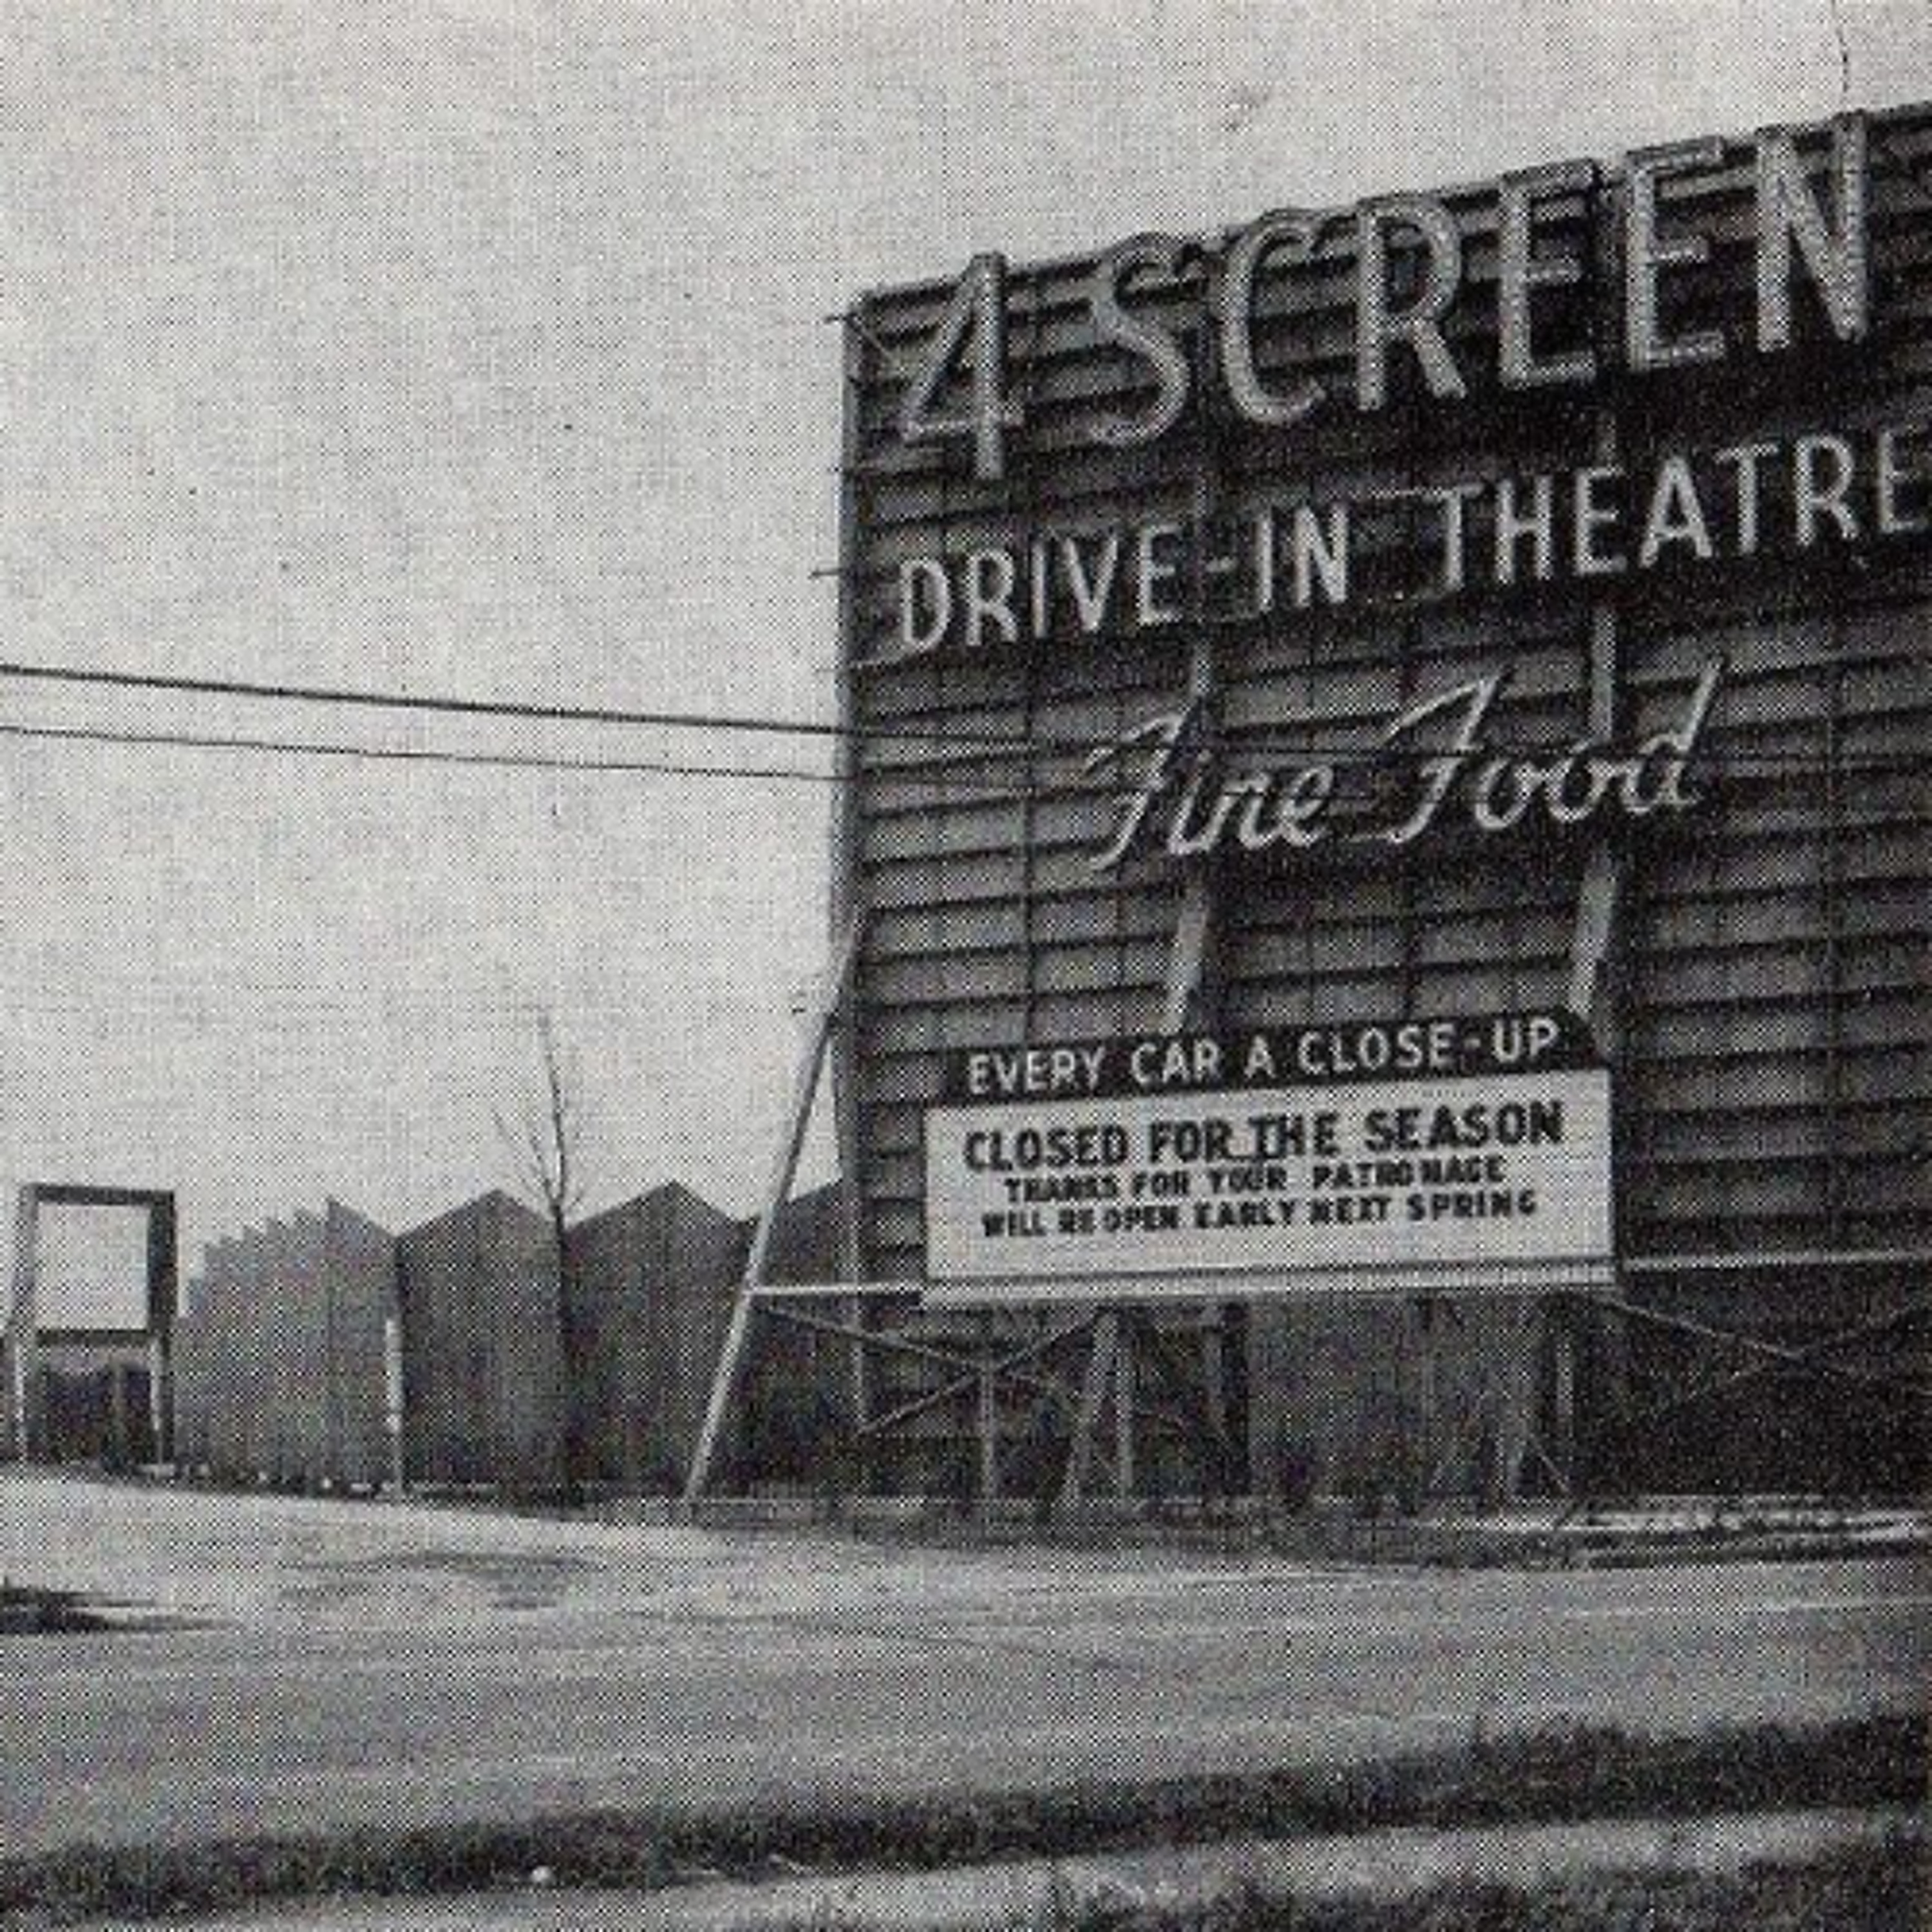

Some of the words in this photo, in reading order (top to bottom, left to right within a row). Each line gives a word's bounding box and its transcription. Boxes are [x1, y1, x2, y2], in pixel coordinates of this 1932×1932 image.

[903, 252, 1025, 479] 4
[1086, 112, 1866, 444] SCREEN
[900, 507, 1349, 652] DRIVE-IN
[1439, 426, 1932, 590] THEATRE
[1088, 694, 1334, 872] Fine
[1349, 656, 1723, 846] Food
[969, 1045, 1106, 1095] EVERY
[1130, 1038, 1222, 1084] CAR
[1244, 1036, 1275, 1079] A
[1297, 1016, 1558, 1074] CLOSE-UP
[965, 1123, 1128, 1170] CLOSED
[1149, 1119, 1231, 1163] FOR
[1249, 1110, 1338, 1159] THE
[1365, 1099, 1564, 1150] SEASON
[981, 1211, 1046, 1238] WILL
[1193, 1199, 1297, 1229] EARLY
[1310, 1195, 1390, 1224] NEXT
[1406, 1189, 1537, 1221] SPRING
[1005, 1176, 1118, 1202] THANKS
[1132, 1171, 1190, 1197] FOR
[1206, 1167, 1287, 1194] YOUR
[1312, 1155, 1504, 1190] PATRONAGE
